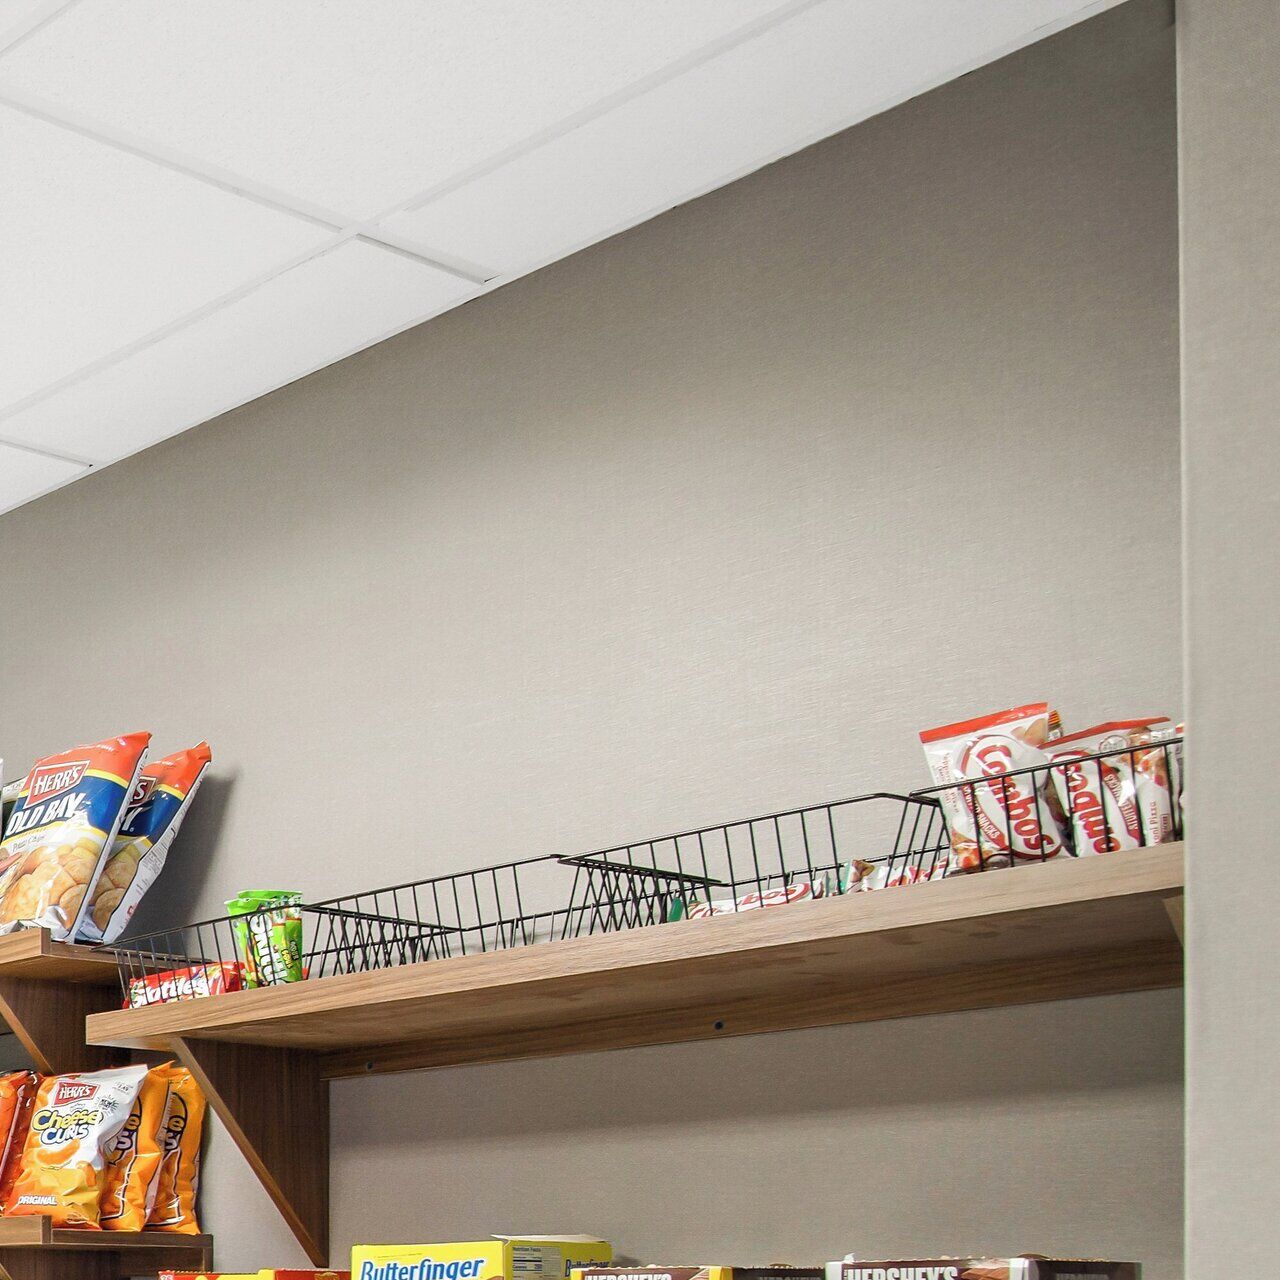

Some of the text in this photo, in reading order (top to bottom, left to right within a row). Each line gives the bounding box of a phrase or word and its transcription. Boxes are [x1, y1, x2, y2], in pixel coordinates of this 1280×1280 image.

[33, 766, 82, 797] HERR'S
[8, 806, 42, 836] OLD
[59, 1084, 93, 1100] HERR'S
[32, 1109, 99, 1131] Cheese
[17, 1195, 58, 1205] ORIGINAL
